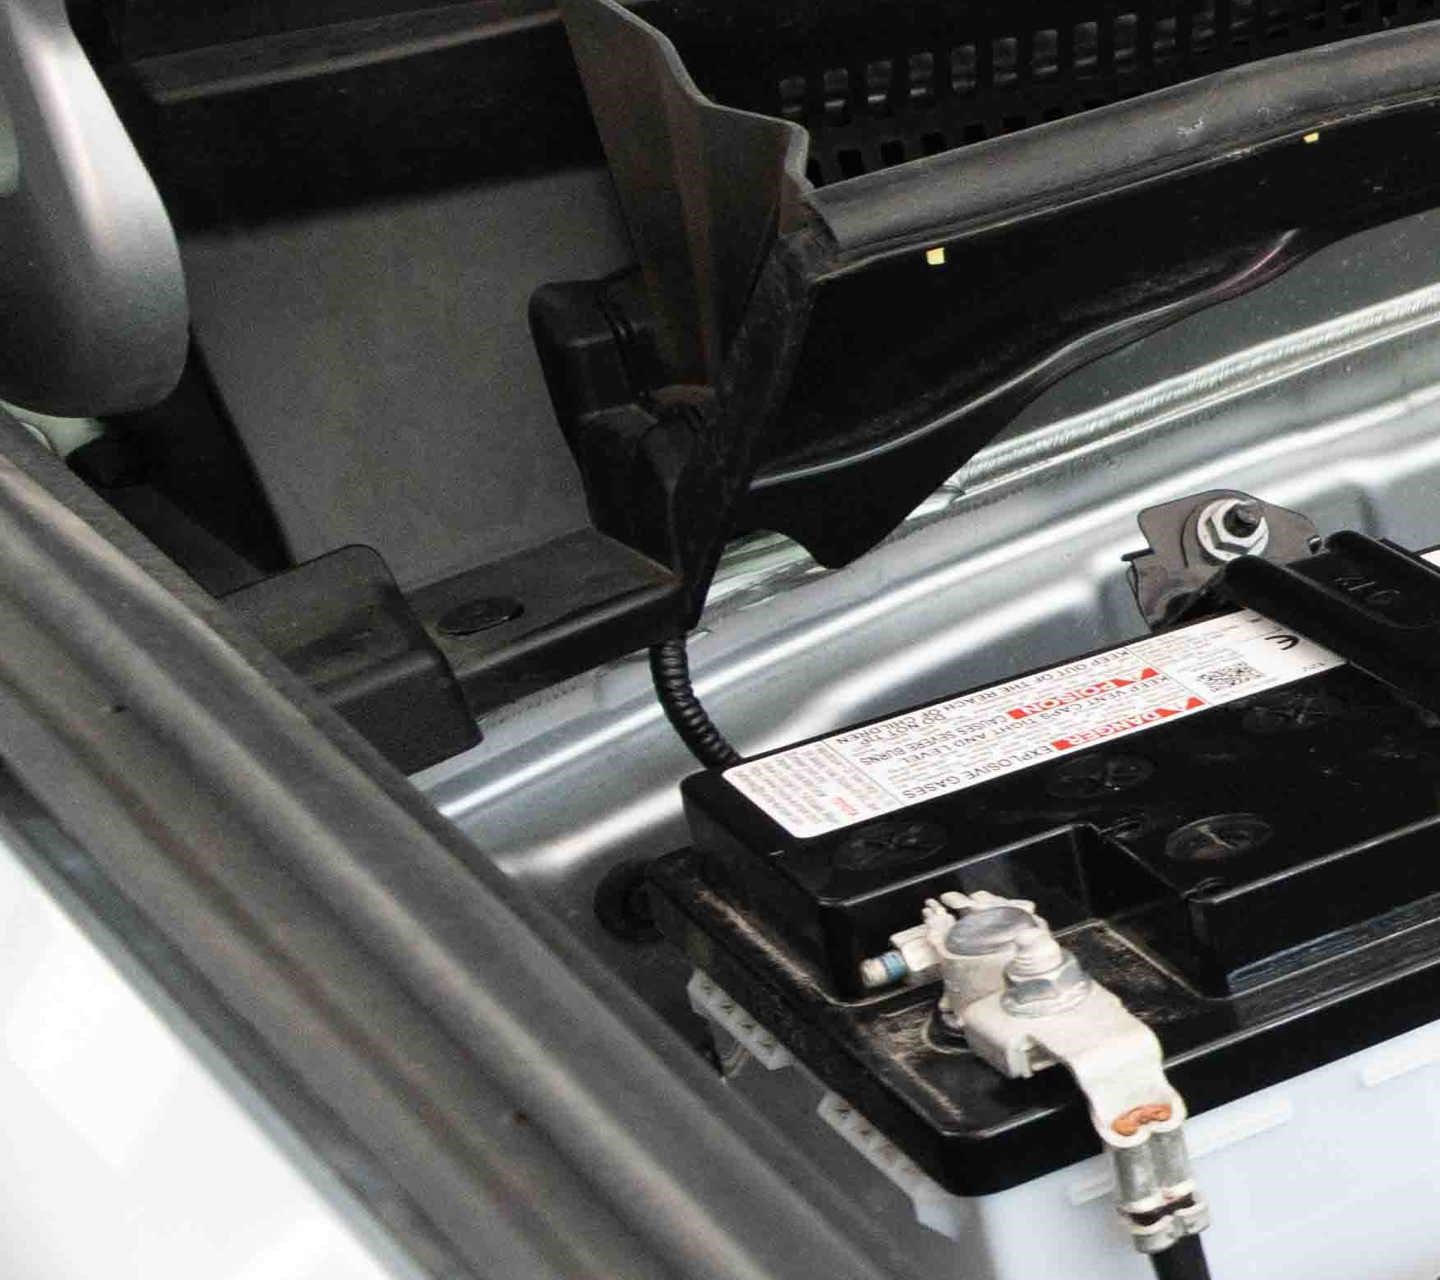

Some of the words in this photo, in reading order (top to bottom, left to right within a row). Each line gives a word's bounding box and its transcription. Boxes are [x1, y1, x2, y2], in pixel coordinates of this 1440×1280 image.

[1085, 648, 1131, 667] KEEP
[1051, 661, 1090, 677] OUT
[996, 680, 1031, 695] THE
[1124, 674, 1171, 693] KEEP
[940, 690, 1000, 713] REACH
[1017, 679, 1118, 716] POISON
[1082, 689, 1126, 706] VENT
[1037, 701, 1085, 721] CAPS
[834, 715, 918, 747] CHILDREN
[953, 713, 1010, 736] CAUSES
[987, 716, 1039, 737] TIGHT
[1062, 709, 1163, 746] DANGER
[902, 730, 958, 752] SEVERE
[950, 732, 990, 748] AND
[857, 746, 907, 767] BURNS
[898, 744, 953, 765] LEVEL
[959, 744, 1055, 780] EXPLOSIVE
[898, 774, 964, 799] GASES
